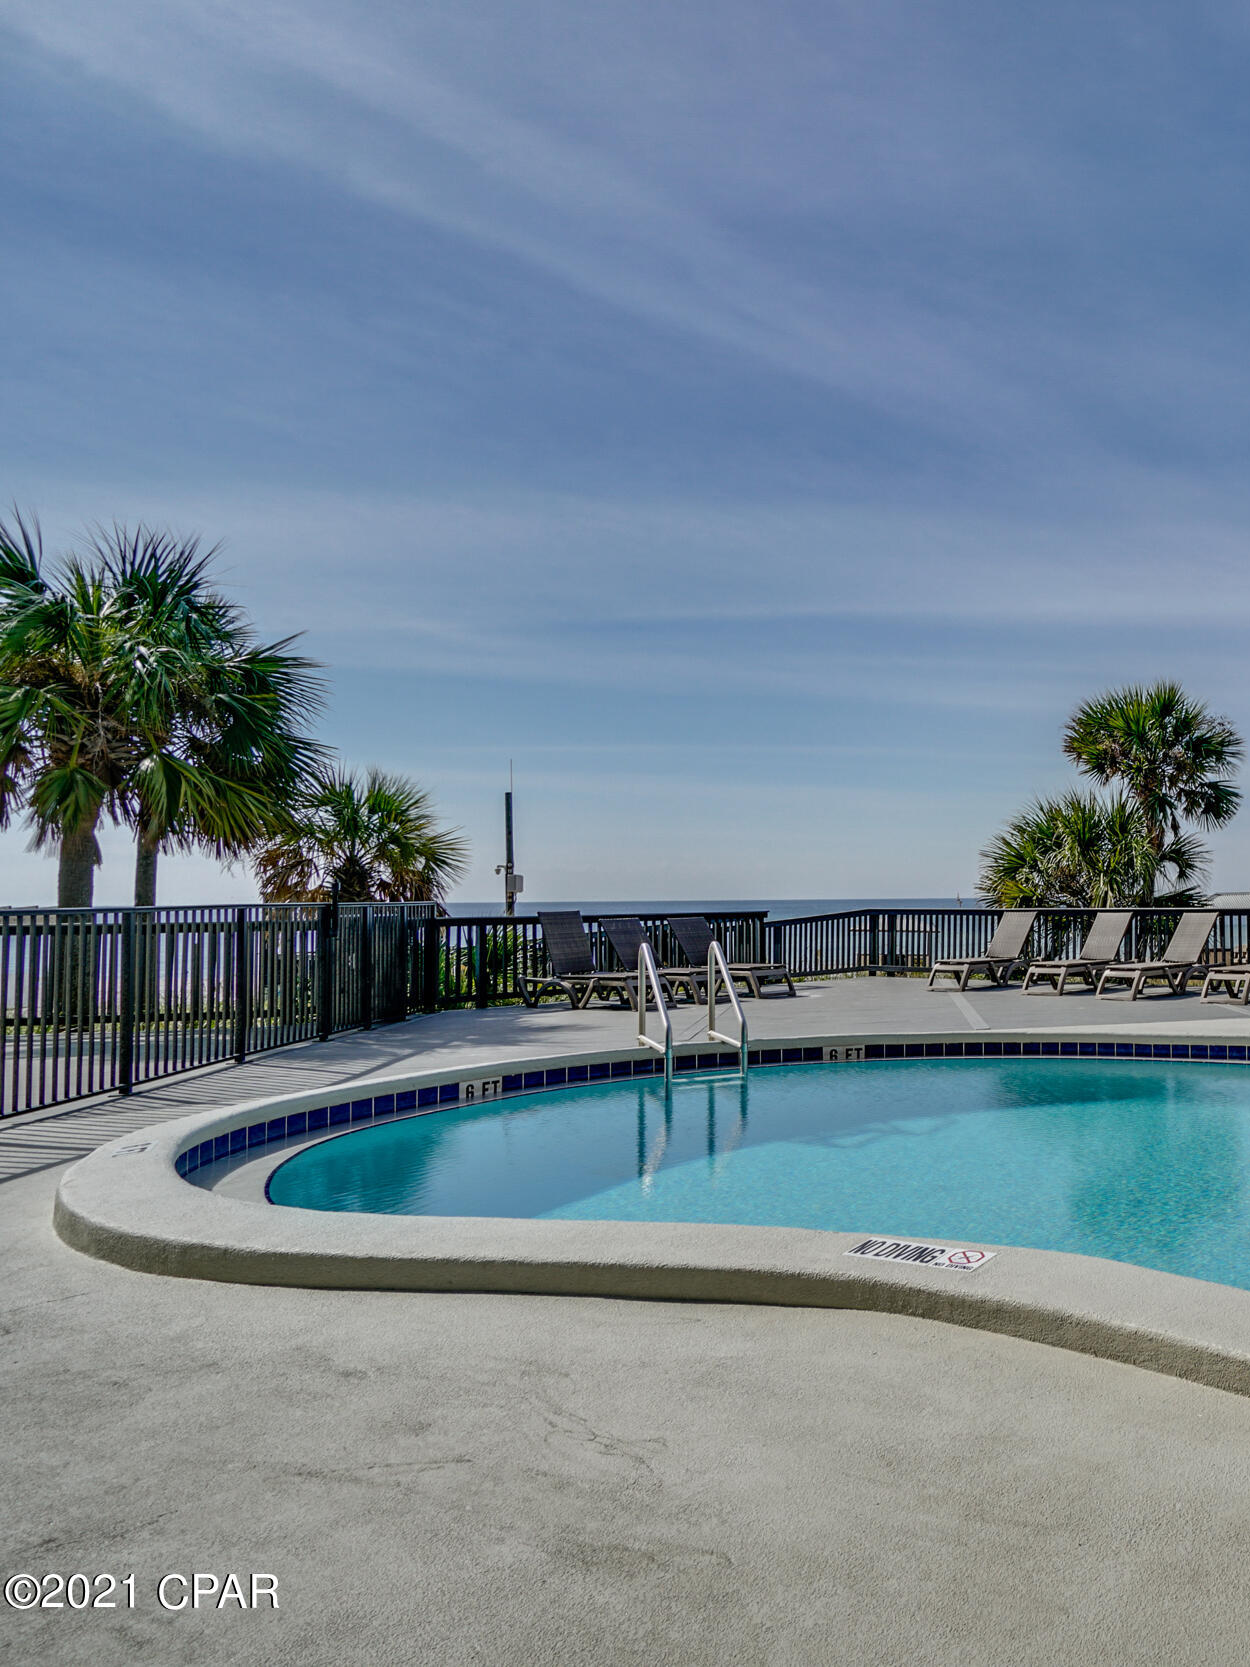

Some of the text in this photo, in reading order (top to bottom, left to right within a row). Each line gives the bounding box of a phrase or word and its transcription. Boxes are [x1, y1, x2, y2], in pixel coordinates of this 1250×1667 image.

[846, 1048, 862, 1060] FT
[482, 1080, 500, 1096] FT
[849, 1240, 946, 1264] NO DIVING
